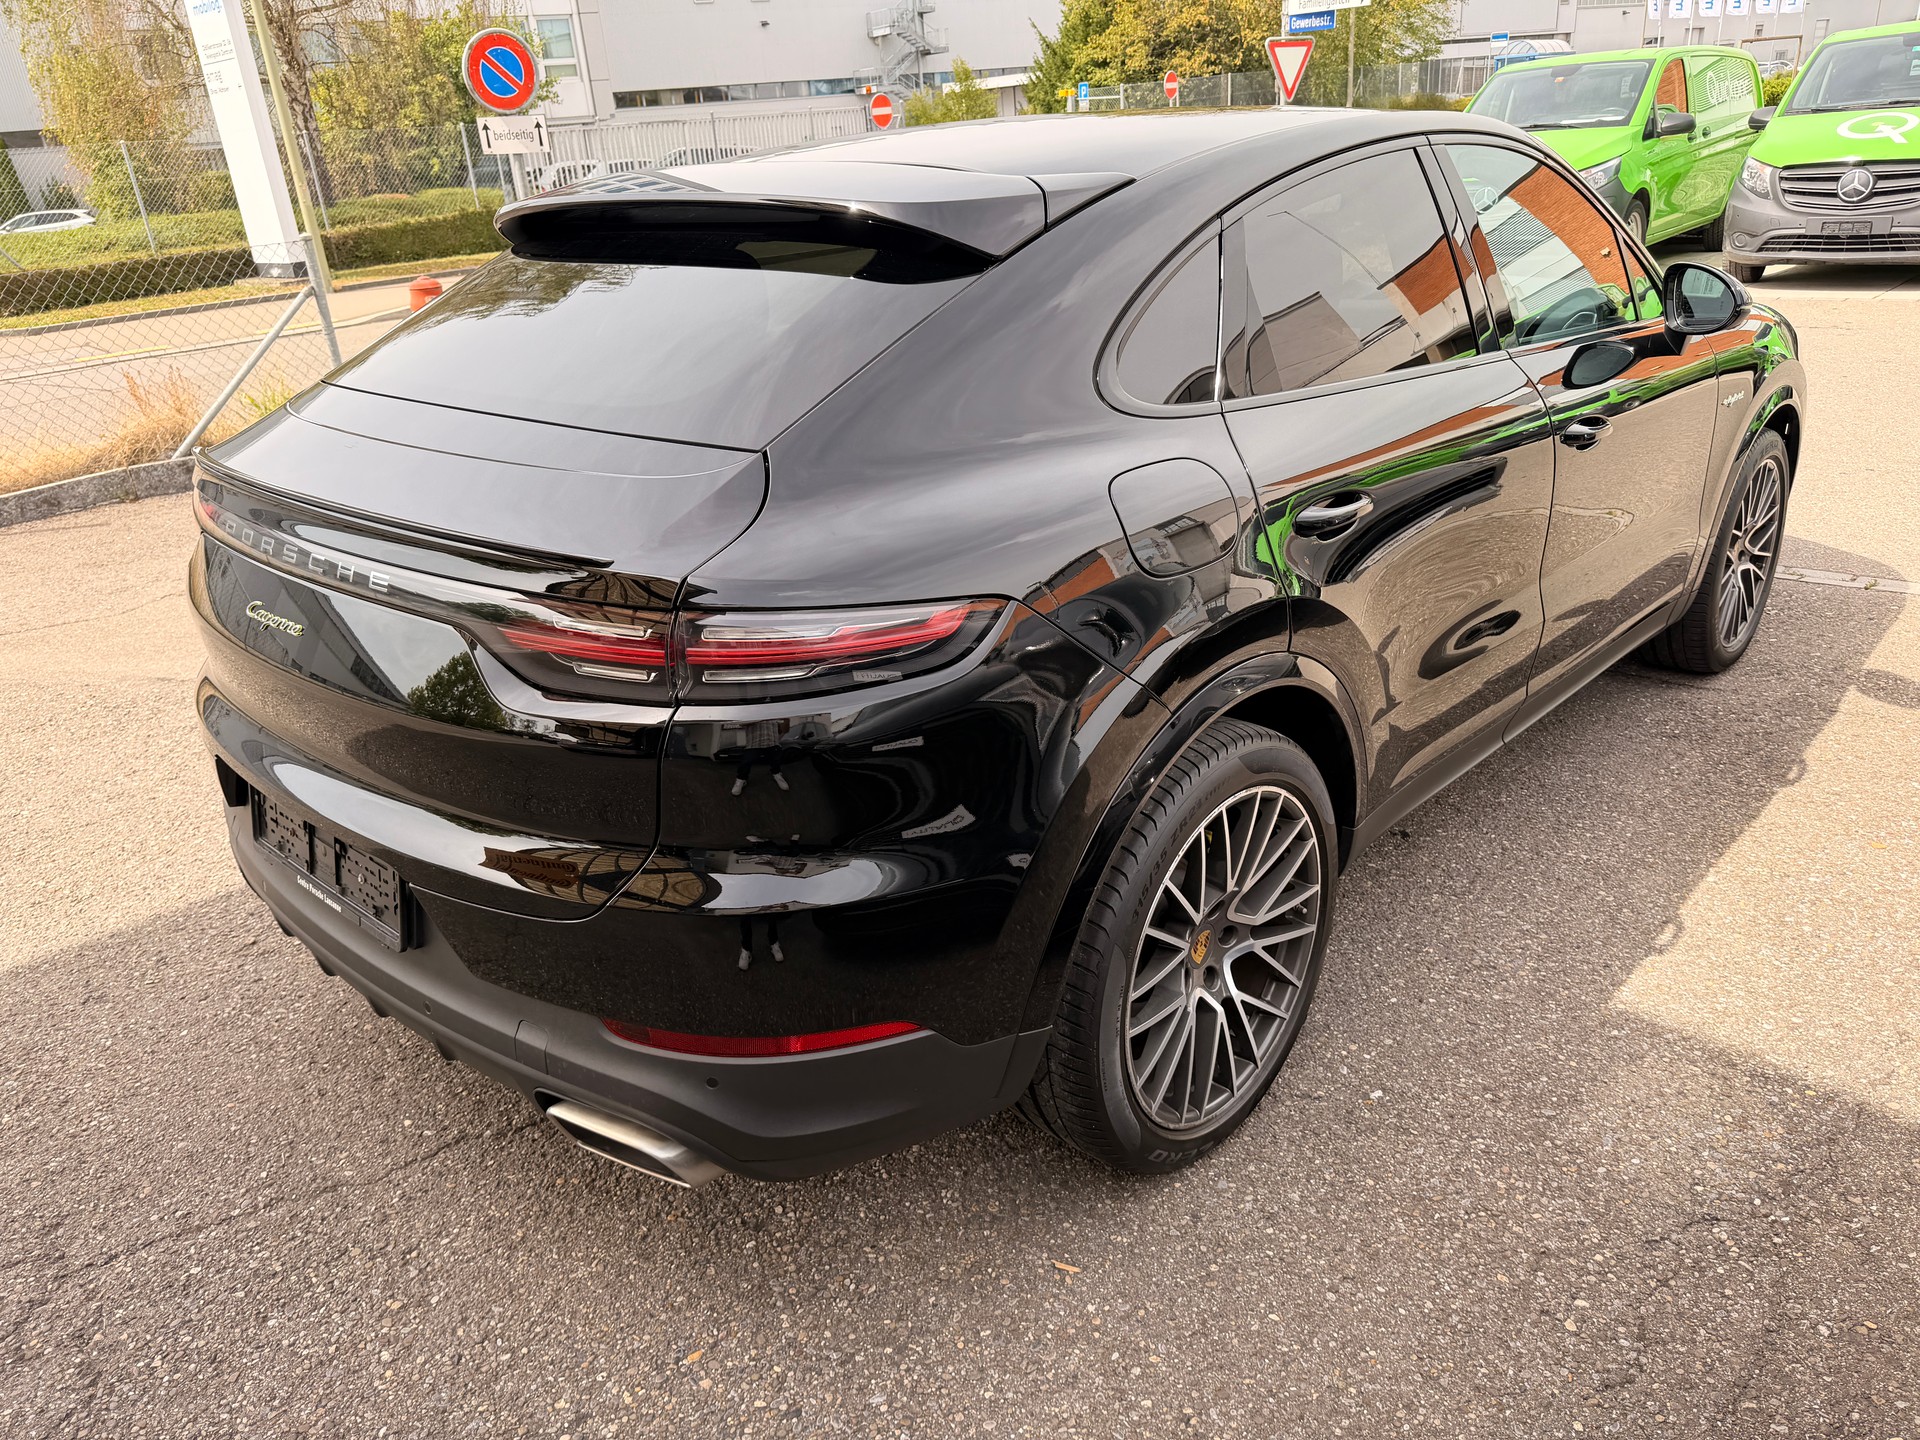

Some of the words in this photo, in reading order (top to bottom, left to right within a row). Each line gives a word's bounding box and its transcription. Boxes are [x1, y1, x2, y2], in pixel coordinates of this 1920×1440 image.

[1291, 14, 1333, 30] Gewerbestr.
[493, 128, 534, 143] beidseitig
[1836, 111, 1920, 144] Q
[225, 520, 390, 592] PORSCHE
[246, 600, 304, 636] Cayenne
